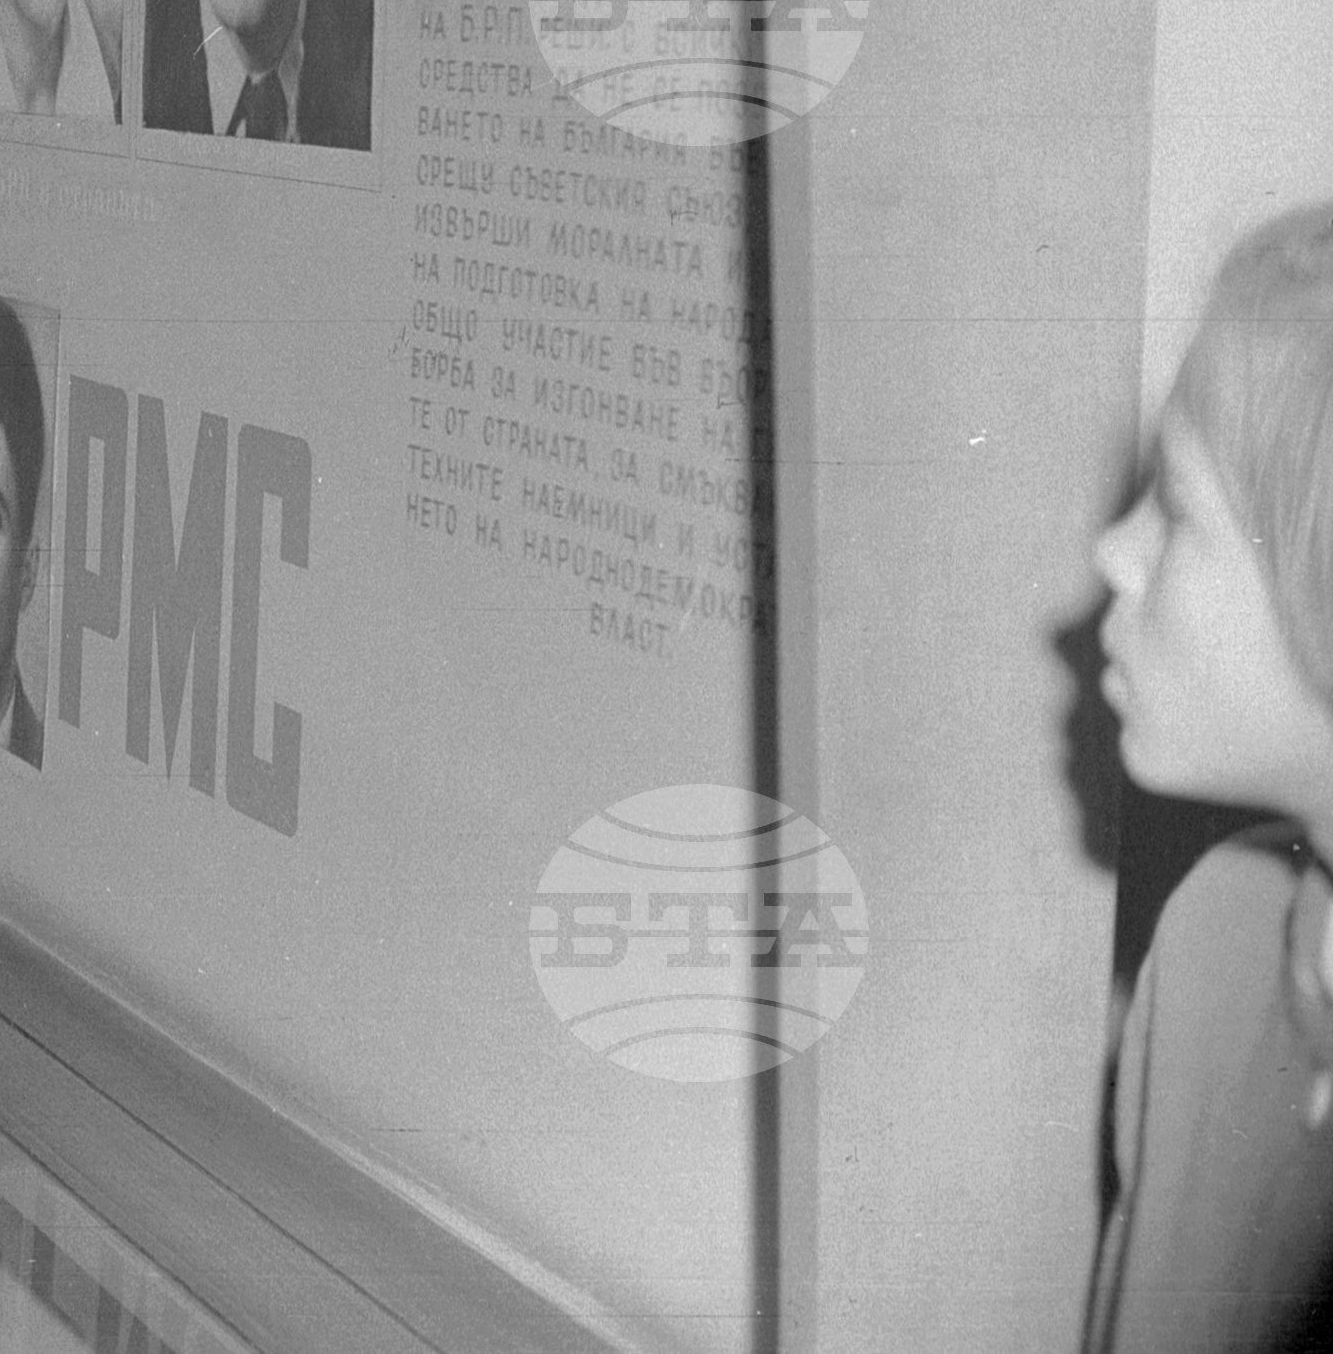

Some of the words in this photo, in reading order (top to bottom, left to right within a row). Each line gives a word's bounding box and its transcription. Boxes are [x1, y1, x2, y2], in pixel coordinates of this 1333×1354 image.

[419, 10, 447, 41] НА
[418, 57, 533, 101] СРЕДСТВА
[417, 105, 503, 144] ВАНЕТО
[519, 117, 546, 147] НА
[416, 154, 494, 195] СРЕЩУ
[510, 164, 647, 214] СЪВЕТСКИЯ
[414, 202, 531, 248] ИЗВЪРШИ
[550, 219, 703, 280] МОРАЛНАТА
[413, 251, 441, 284] НА
[453, 256, 599, 315] ПОДГОТОВКА
[621, 290, 651, 324] НА
[412, 299, 478, 344] ОБЩО
[501, 319, 612, 372] УЧАСТИЕ
[410, 346, 476, 392] БОРБА
[491, 365, 516, 399] ЗА
[534, 377, 680, 442] ИЗГОНВАНЕ
[409, 396, 432, 430] ТЕ
[444, 406, 470, 436] ОТ
[611, 447, 640, 488] ЗА
[406, 493, 458, 536] НЕТО
[475, 514, 503, 552] НА
[408, 443, 504, 502] ТЕХНИТЕ
[522, 476, 657, 550] НАЕМНИЦИ
[59, 374, 313, 838] РМС
